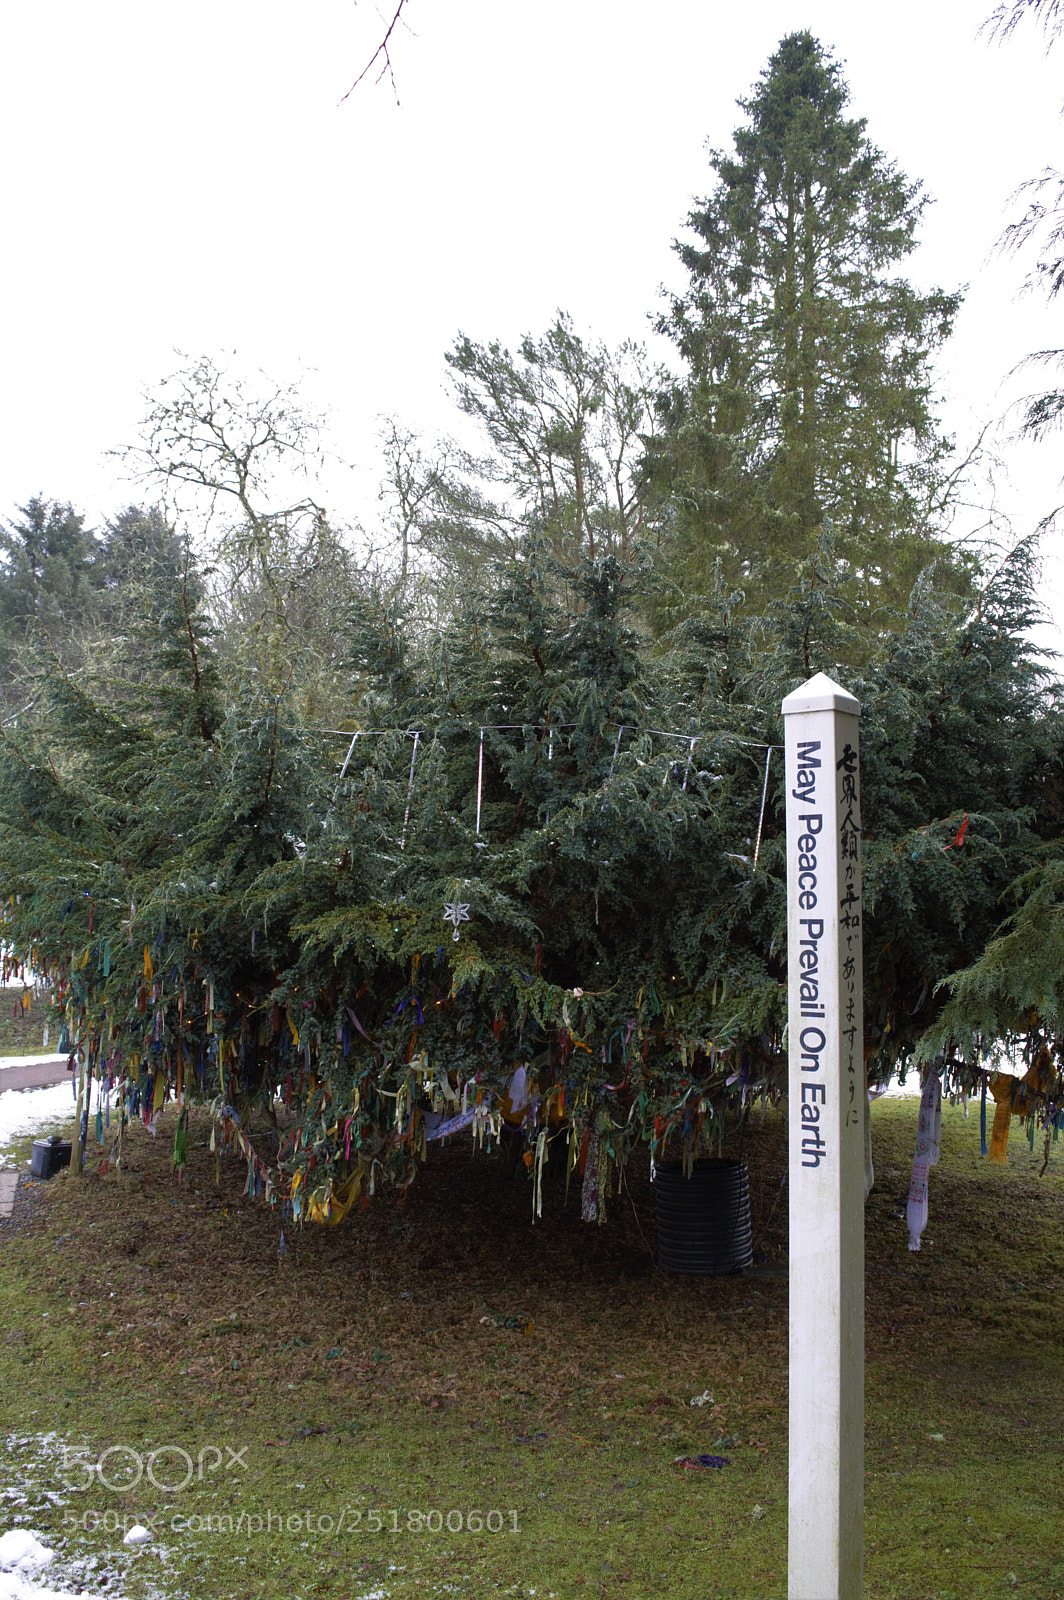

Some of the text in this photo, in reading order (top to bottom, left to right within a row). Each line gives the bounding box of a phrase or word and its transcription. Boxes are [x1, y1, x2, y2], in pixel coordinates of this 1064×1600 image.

[792, 741, 827, 1168] May Peace Prevail On Earth
